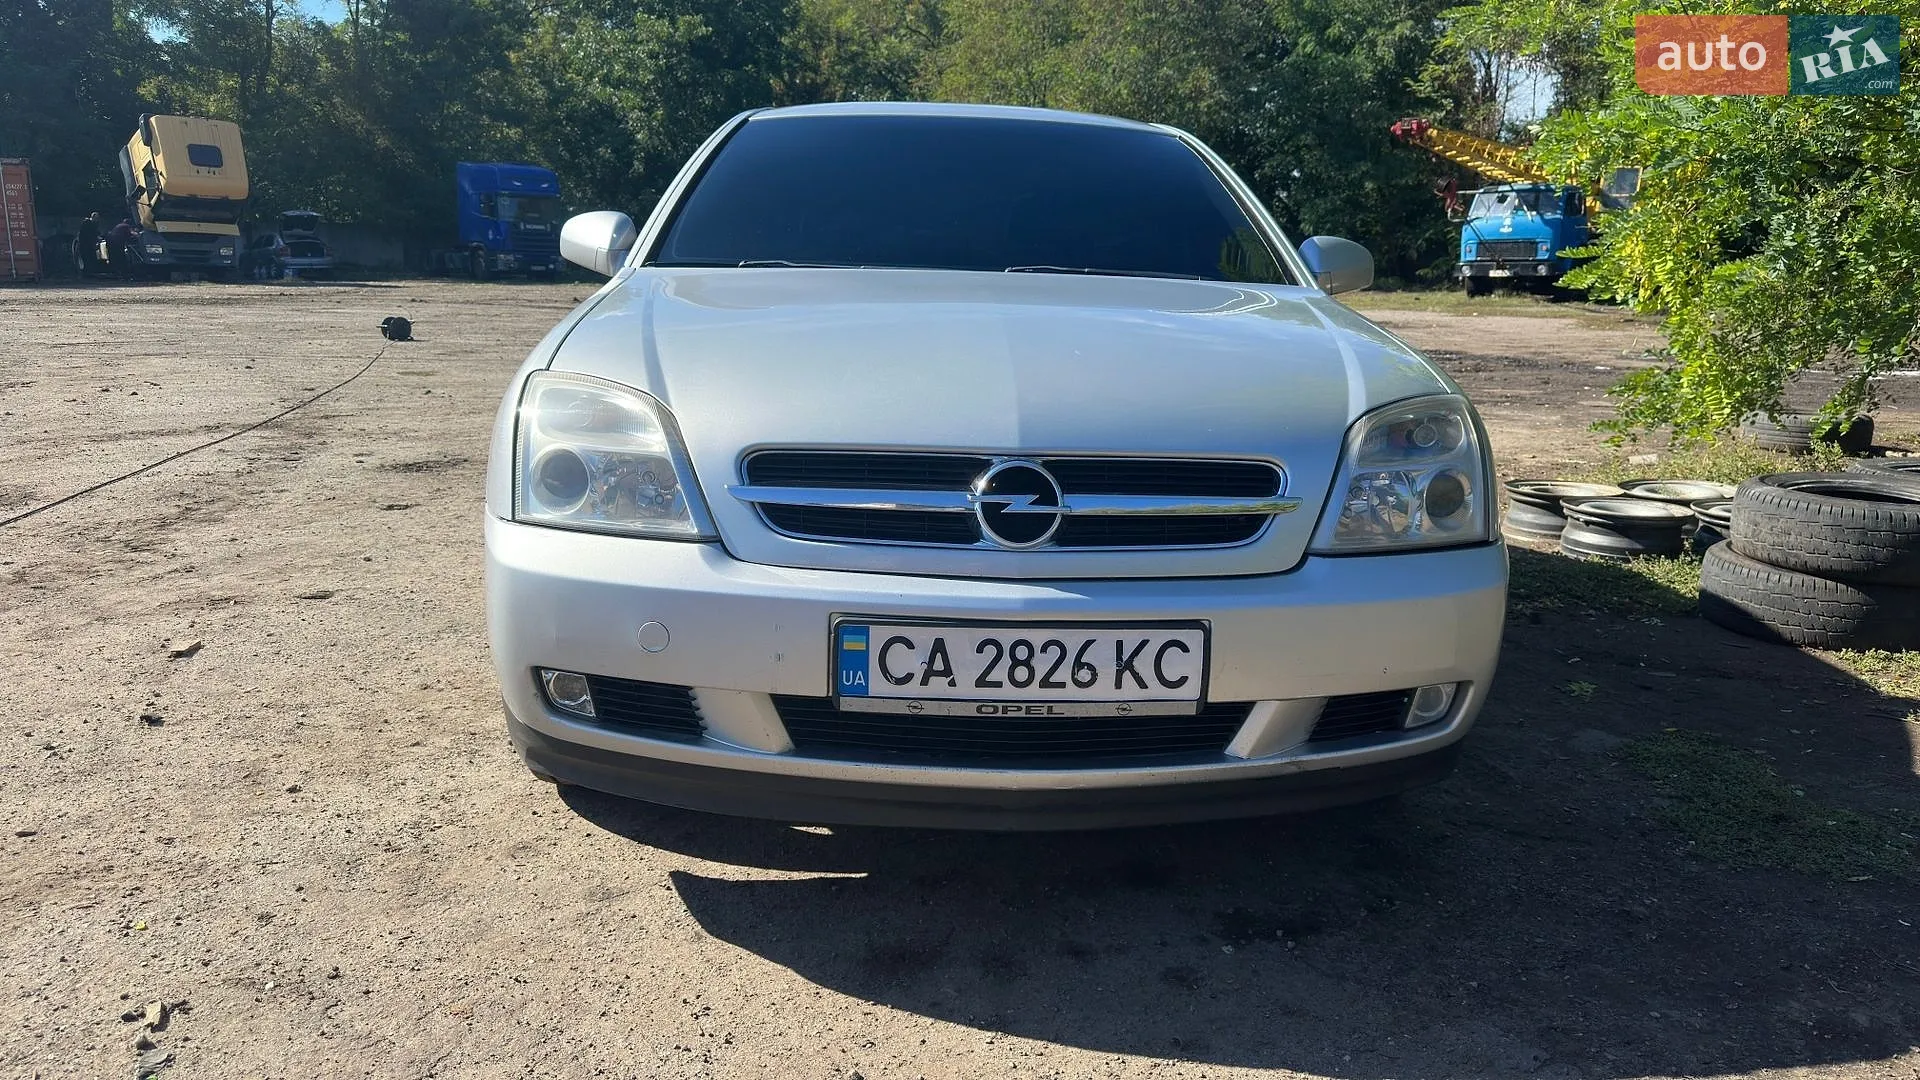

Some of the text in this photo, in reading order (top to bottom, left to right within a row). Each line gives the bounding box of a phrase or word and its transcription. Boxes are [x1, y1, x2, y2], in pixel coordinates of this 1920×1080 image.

[877, 635, 1191, 690] CA 2826 KC
[843, 670, 866, 687] UA
[975, 704, 1065, 716] OPEL
